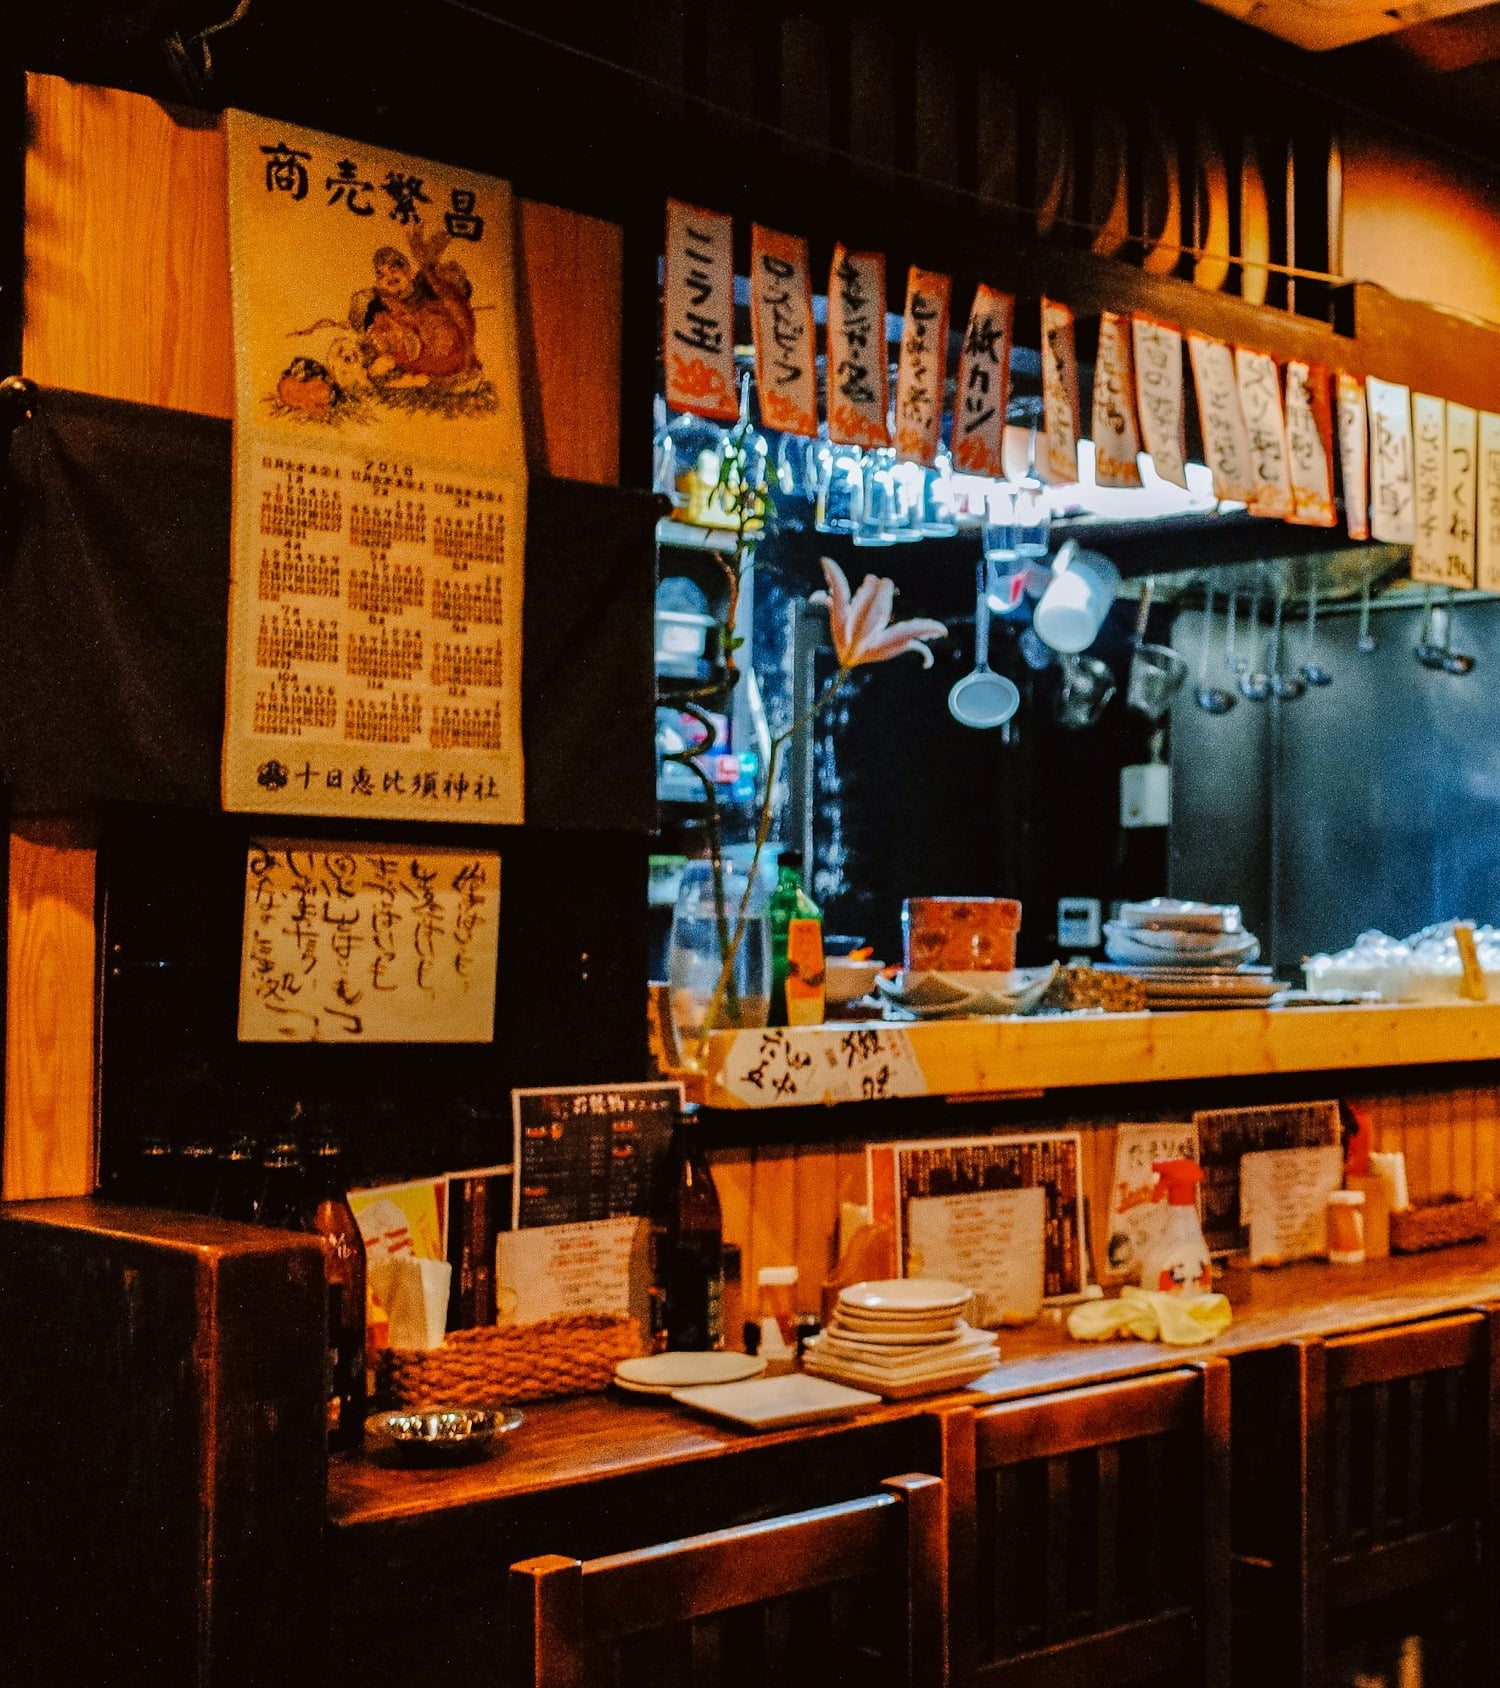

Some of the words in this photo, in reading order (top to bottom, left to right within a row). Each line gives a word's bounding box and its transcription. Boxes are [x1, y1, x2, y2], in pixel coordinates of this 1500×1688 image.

[260, 142, 484, 241] 商売繁昌
[295, 761, 499, 801] 十日恵比須神社
